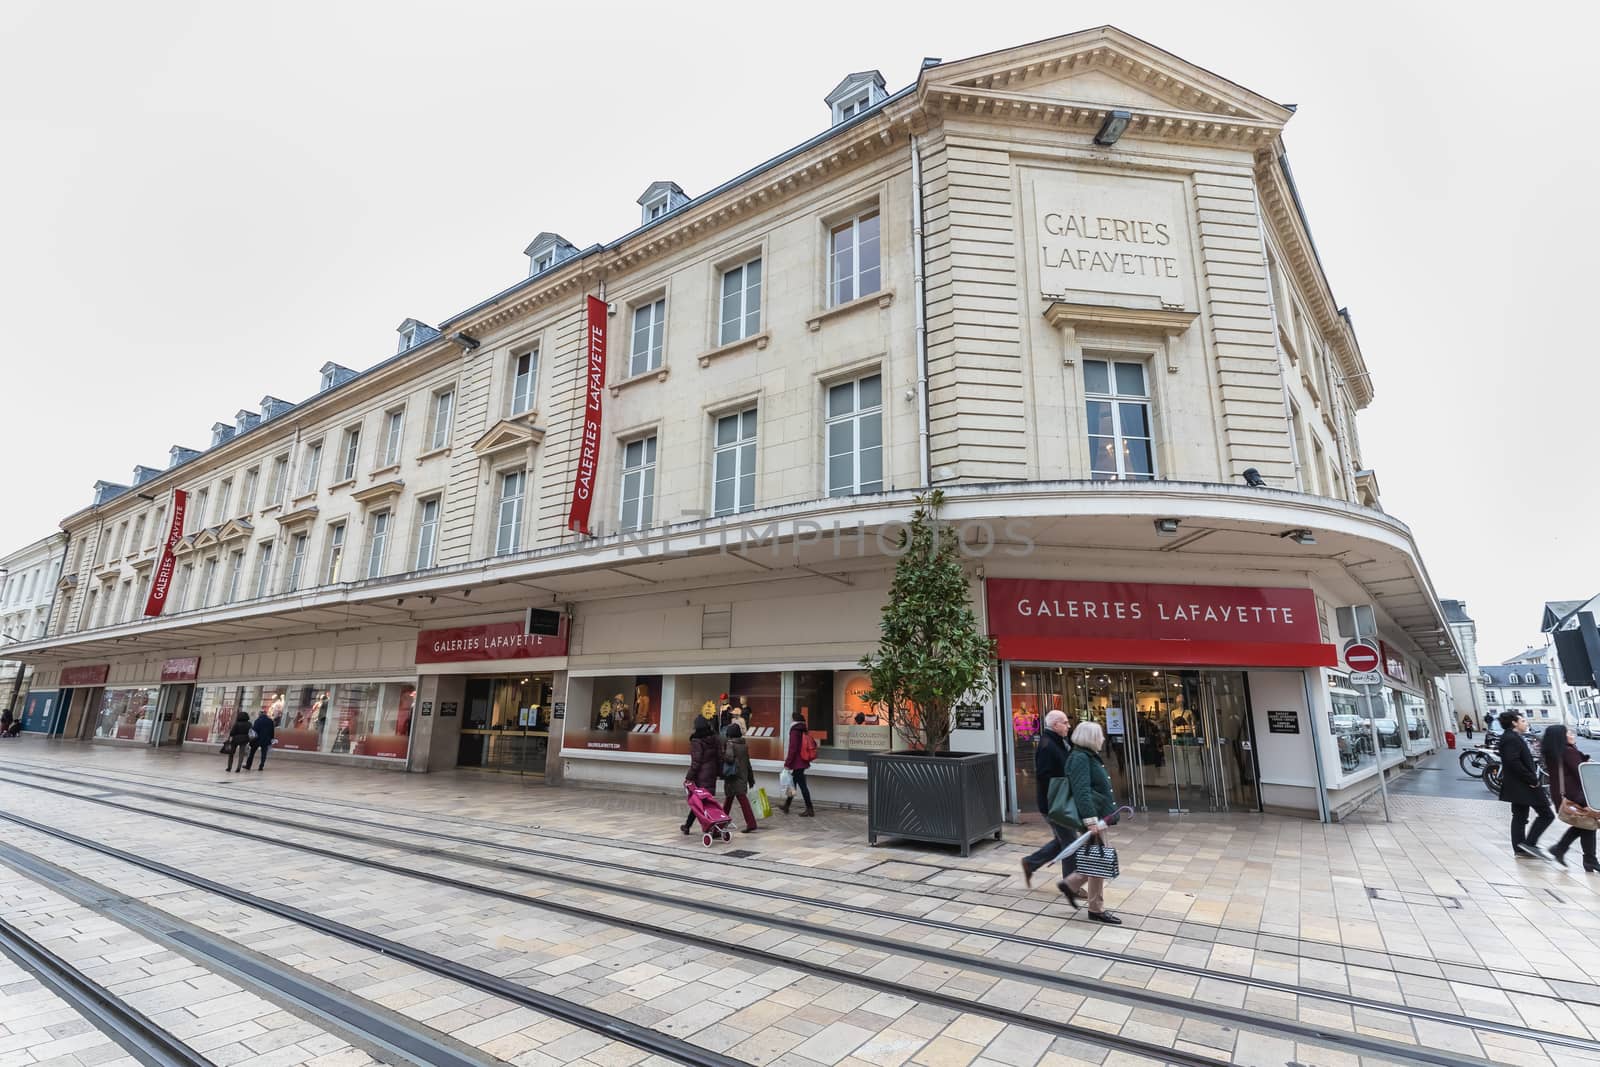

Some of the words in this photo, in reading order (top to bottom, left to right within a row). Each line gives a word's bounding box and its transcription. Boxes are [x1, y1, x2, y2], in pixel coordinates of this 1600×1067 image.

[1043, 213, 1170, 246] GALERIES
[1042, 246, 1179, 278] LAFAYETTE
[578, 421, 598, 500] GALERIES
[589, 325, 603, 412] LAFAYETTE
[154, 559, 172, 599] GALERIES
[169, 506, 183, 552] AFAYETTE
[1017, 599, 1143, 620] GALERIES
[1157, 603, 1294, 624] LAFAYETTE
[434, 639, 480, 652] GALERIES
[485, 634, 542, 648] LAFAYETTE
